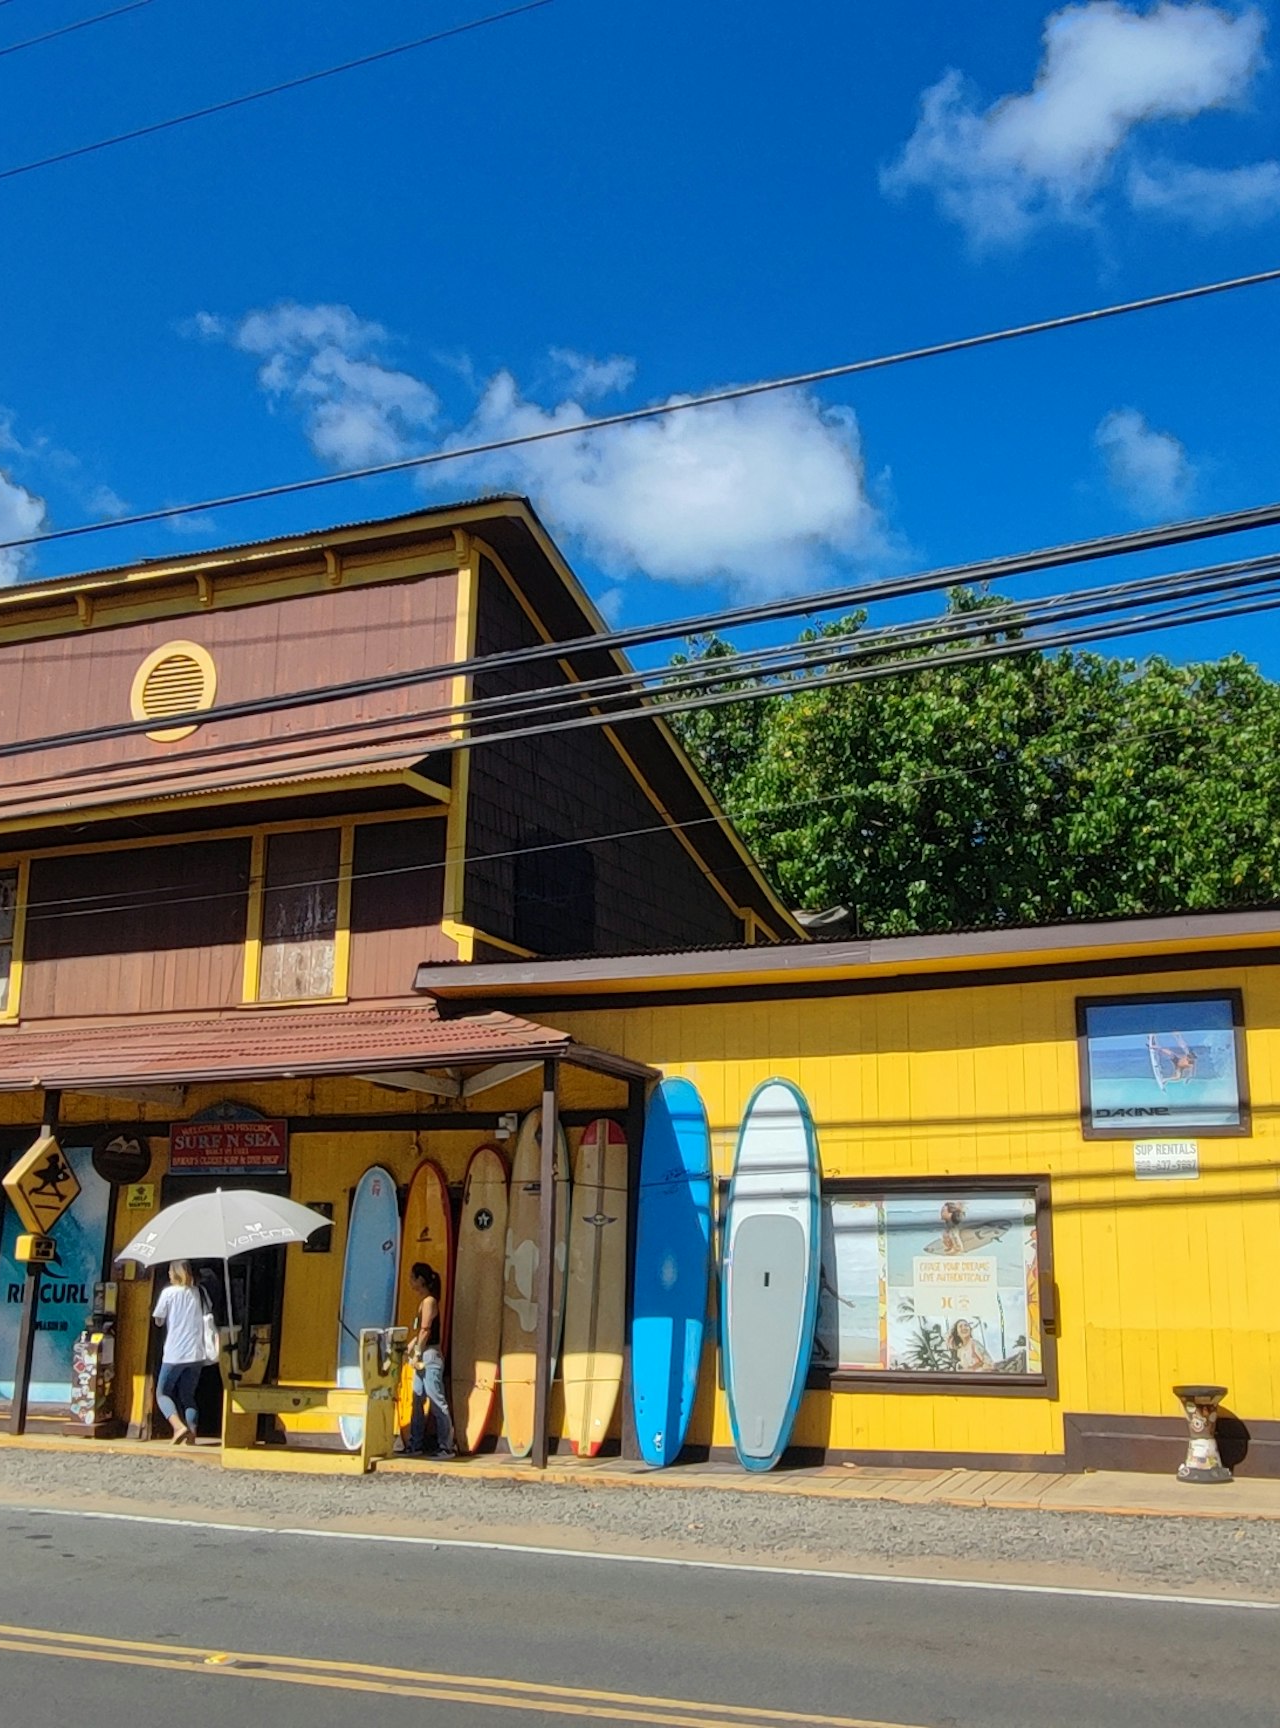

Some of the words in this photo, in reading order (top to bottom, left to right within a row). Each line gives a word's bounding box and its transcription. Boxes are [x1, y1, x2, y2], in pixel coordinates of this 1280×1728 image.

[175, 1134, 222, 1150] SURF
[227, 1134, 240, 1148] N
[245, 1132, 280, 1147] SEA
[1135, 1144, 1154, 1156] SUP
[1156, 1143, 1196, 1155] RENTALS
[227, 1227, 295, 1249] vertra
[40, 1284, 89, 1303] CURL
